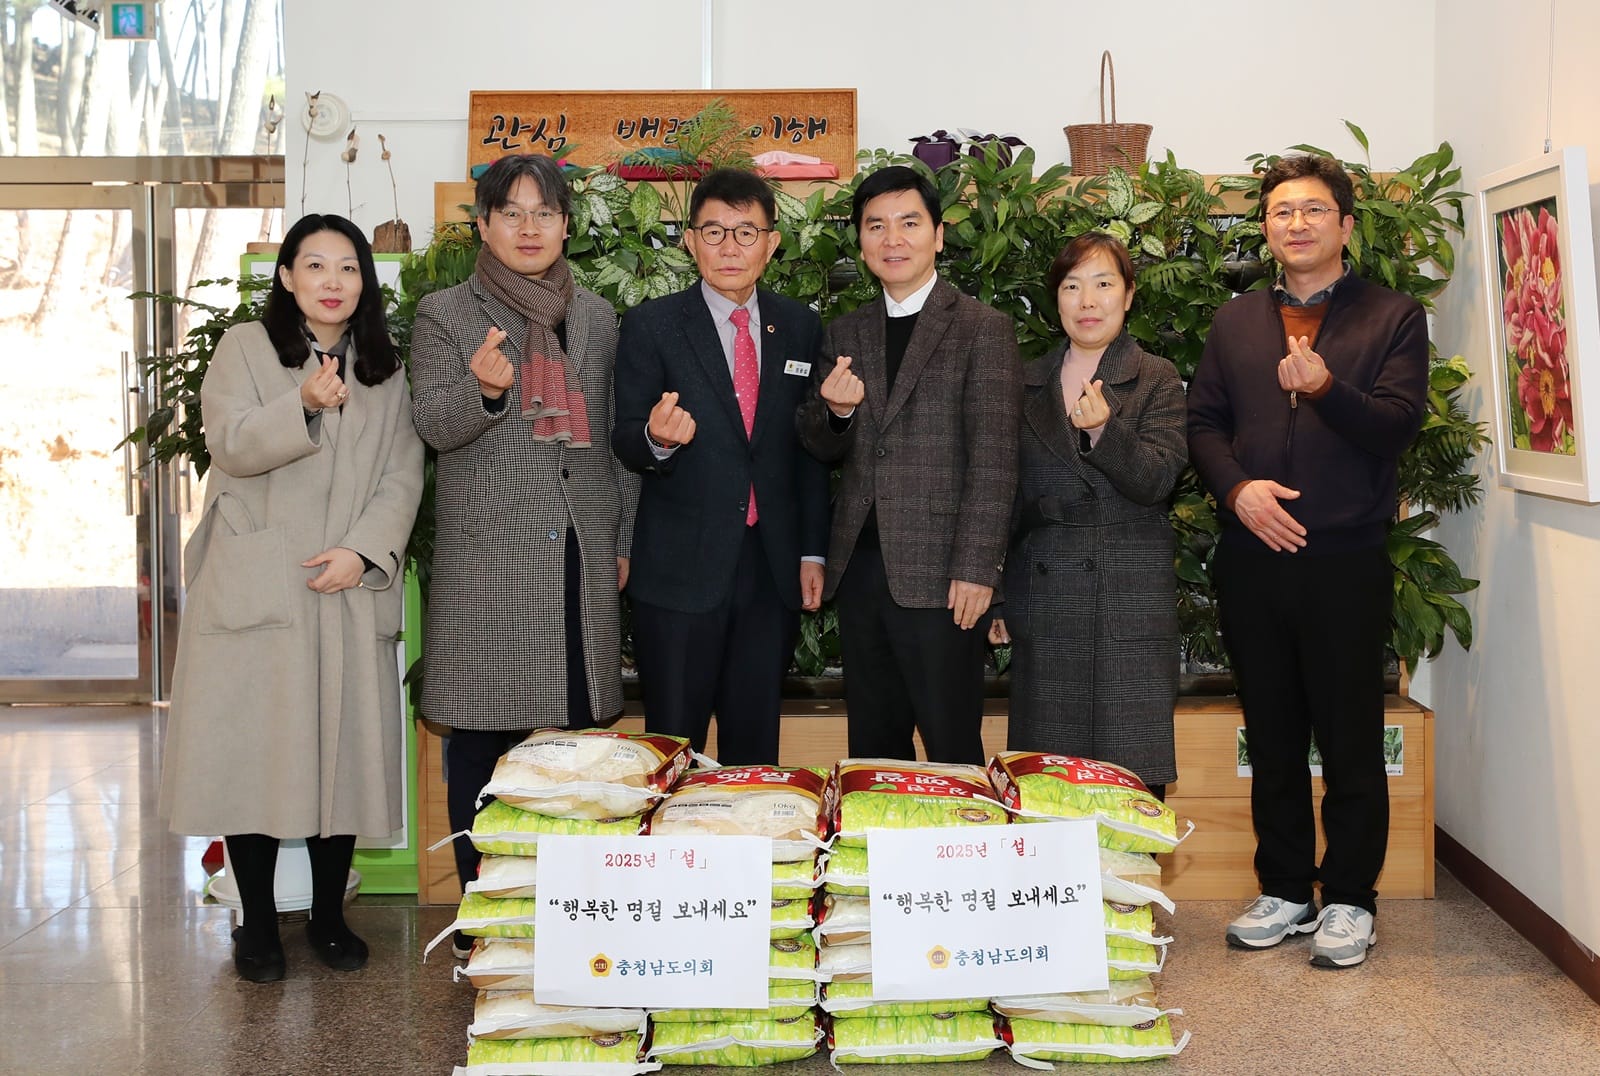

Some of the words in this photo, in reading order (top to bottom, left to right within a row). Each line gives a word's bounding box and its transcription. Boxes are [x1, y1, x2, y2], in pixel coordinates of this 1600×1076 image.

[482, 114, 568, 152] 관심
[749, 115, 828, 145] 이해
[605, 852, 656, 869] 2025년
[936, 841, 988, 859] 2025년
[626, 898, 662, 922] 명절
[962, 888, 996, 912] 명절
[954, 945, 1049, 967] 충청남도의회
[616, 958, 713, 977] 충청남도의회
